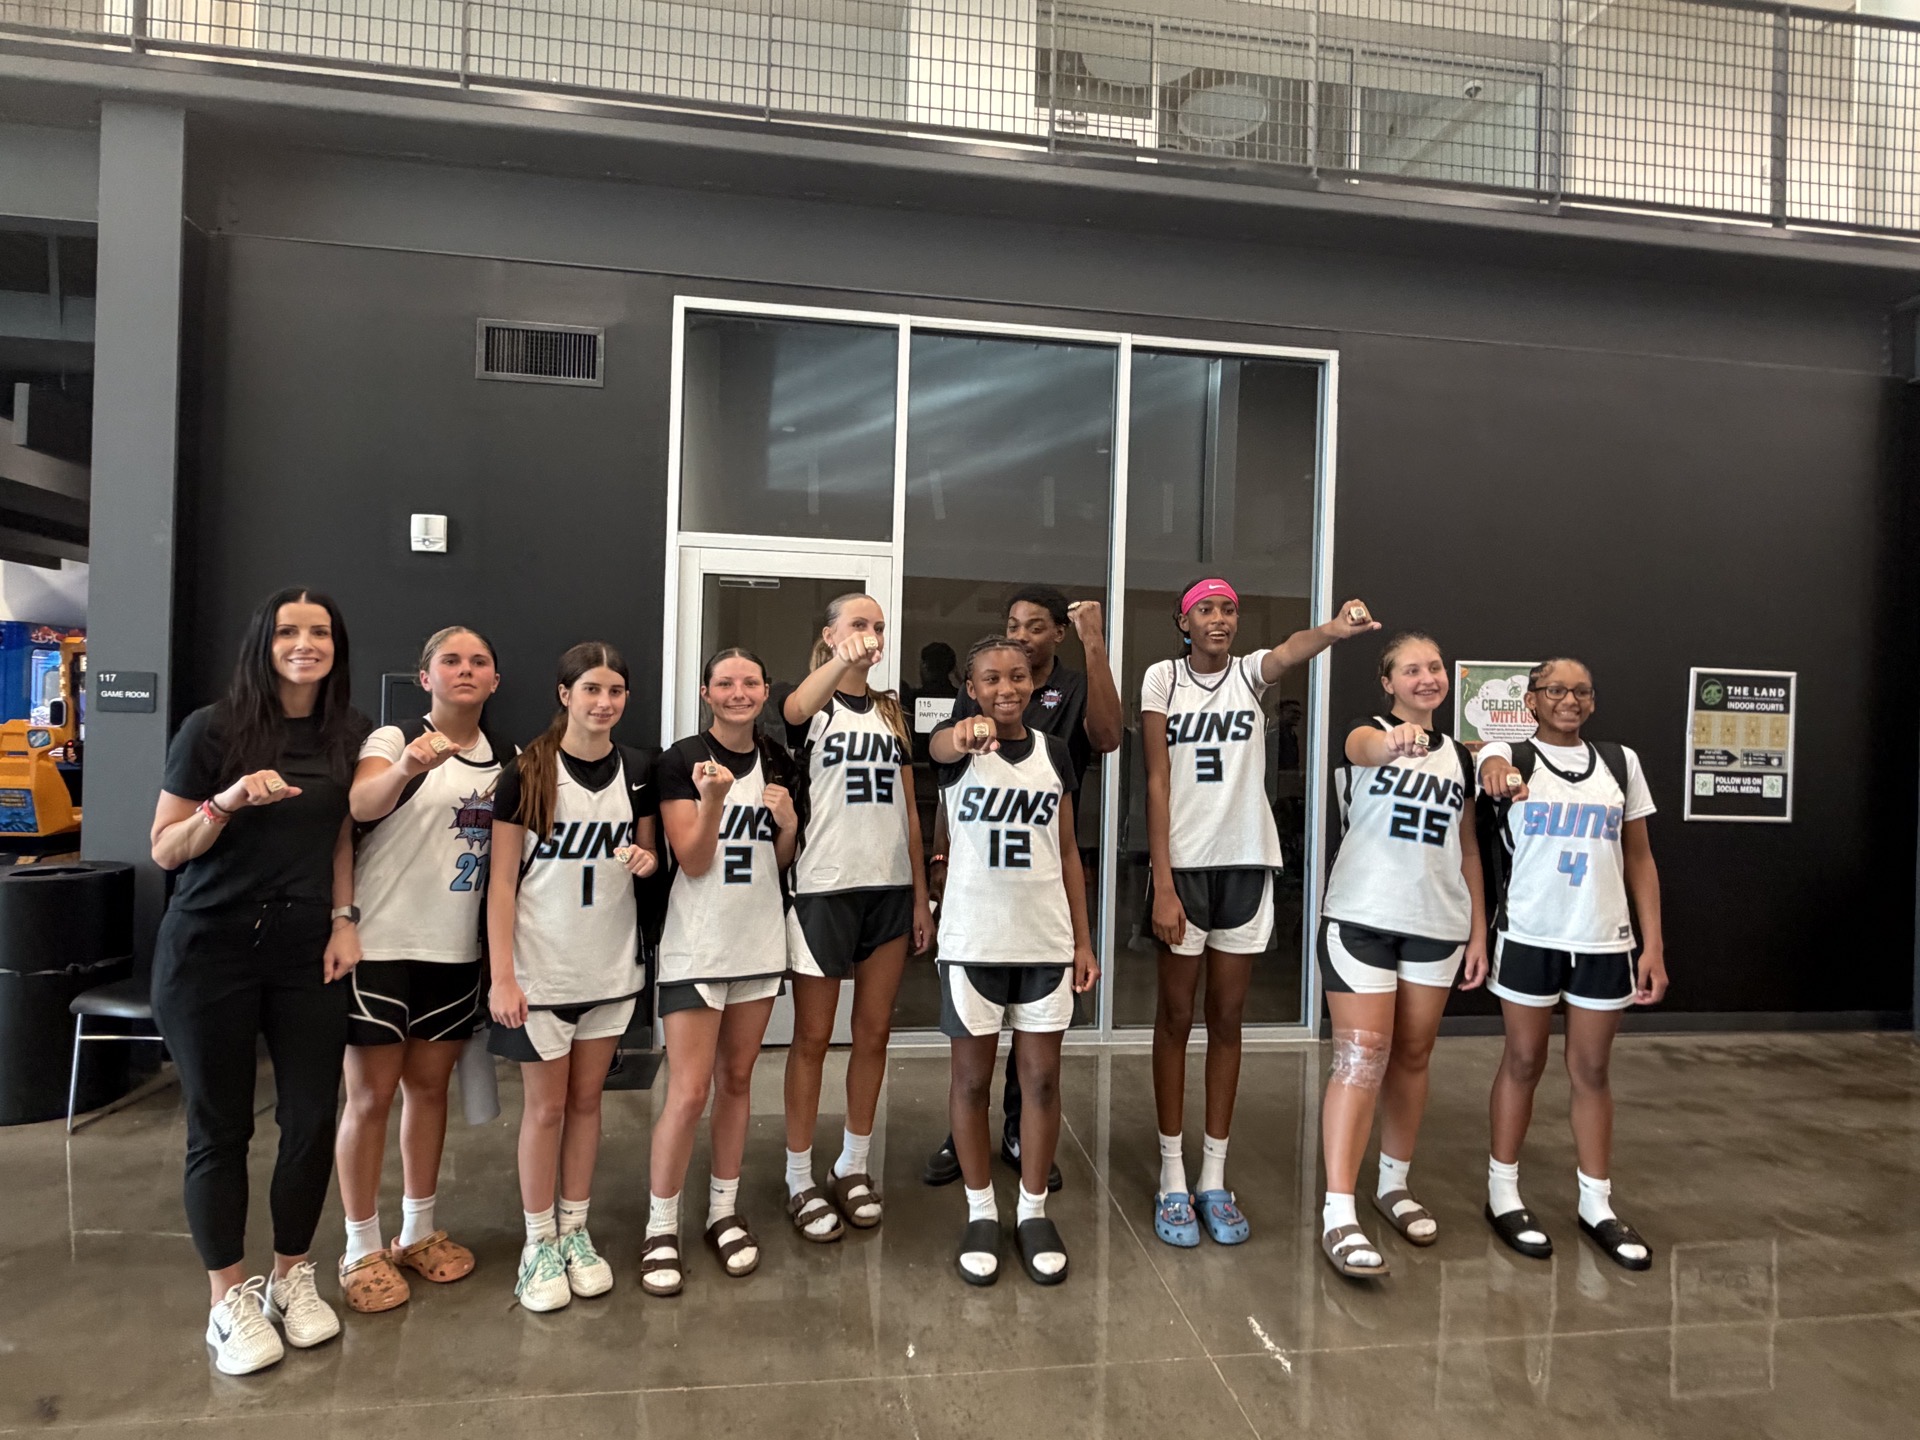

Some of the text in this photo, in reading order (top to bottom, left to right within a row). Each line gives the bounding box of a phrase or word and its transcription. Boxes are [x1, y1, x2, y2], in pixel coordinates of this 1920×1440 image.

[99, 674, 116, 682] 117
[101, 690, 124, 698] GAME
[1727, 686, 1785, 697] THE LAND
[1481, 699, 1526, 711] CELEBR
[1490, 711, 1518, 723] WITH
[1727, 701, 1784, 711] INDOOR COURTS
[1166, 710, 1255, 746] SUNS
[1196, 748, 1223, 782] 3
[1715, 776, 1741, 785] FOLLOW
[1742, 777, 1751, 785] US
[846, 767, 895, 804] 35
[1369, 765, 1464, 812] SUNS
[1716, 785, 1761, 793] SOCIAL MEDIA
[958, 787, 1058, 826] SUNS
[1524, 802, 1621, 841] SUNS
[1390, 803, 1451, 847] 25
[724, 846, 752, 884] 2
[989, 829, 1031, 869] 12
[450, 853, 489, 891] 21
[581, 865, 595, 907] 1
[1557, 851, 1588, 887] 4
